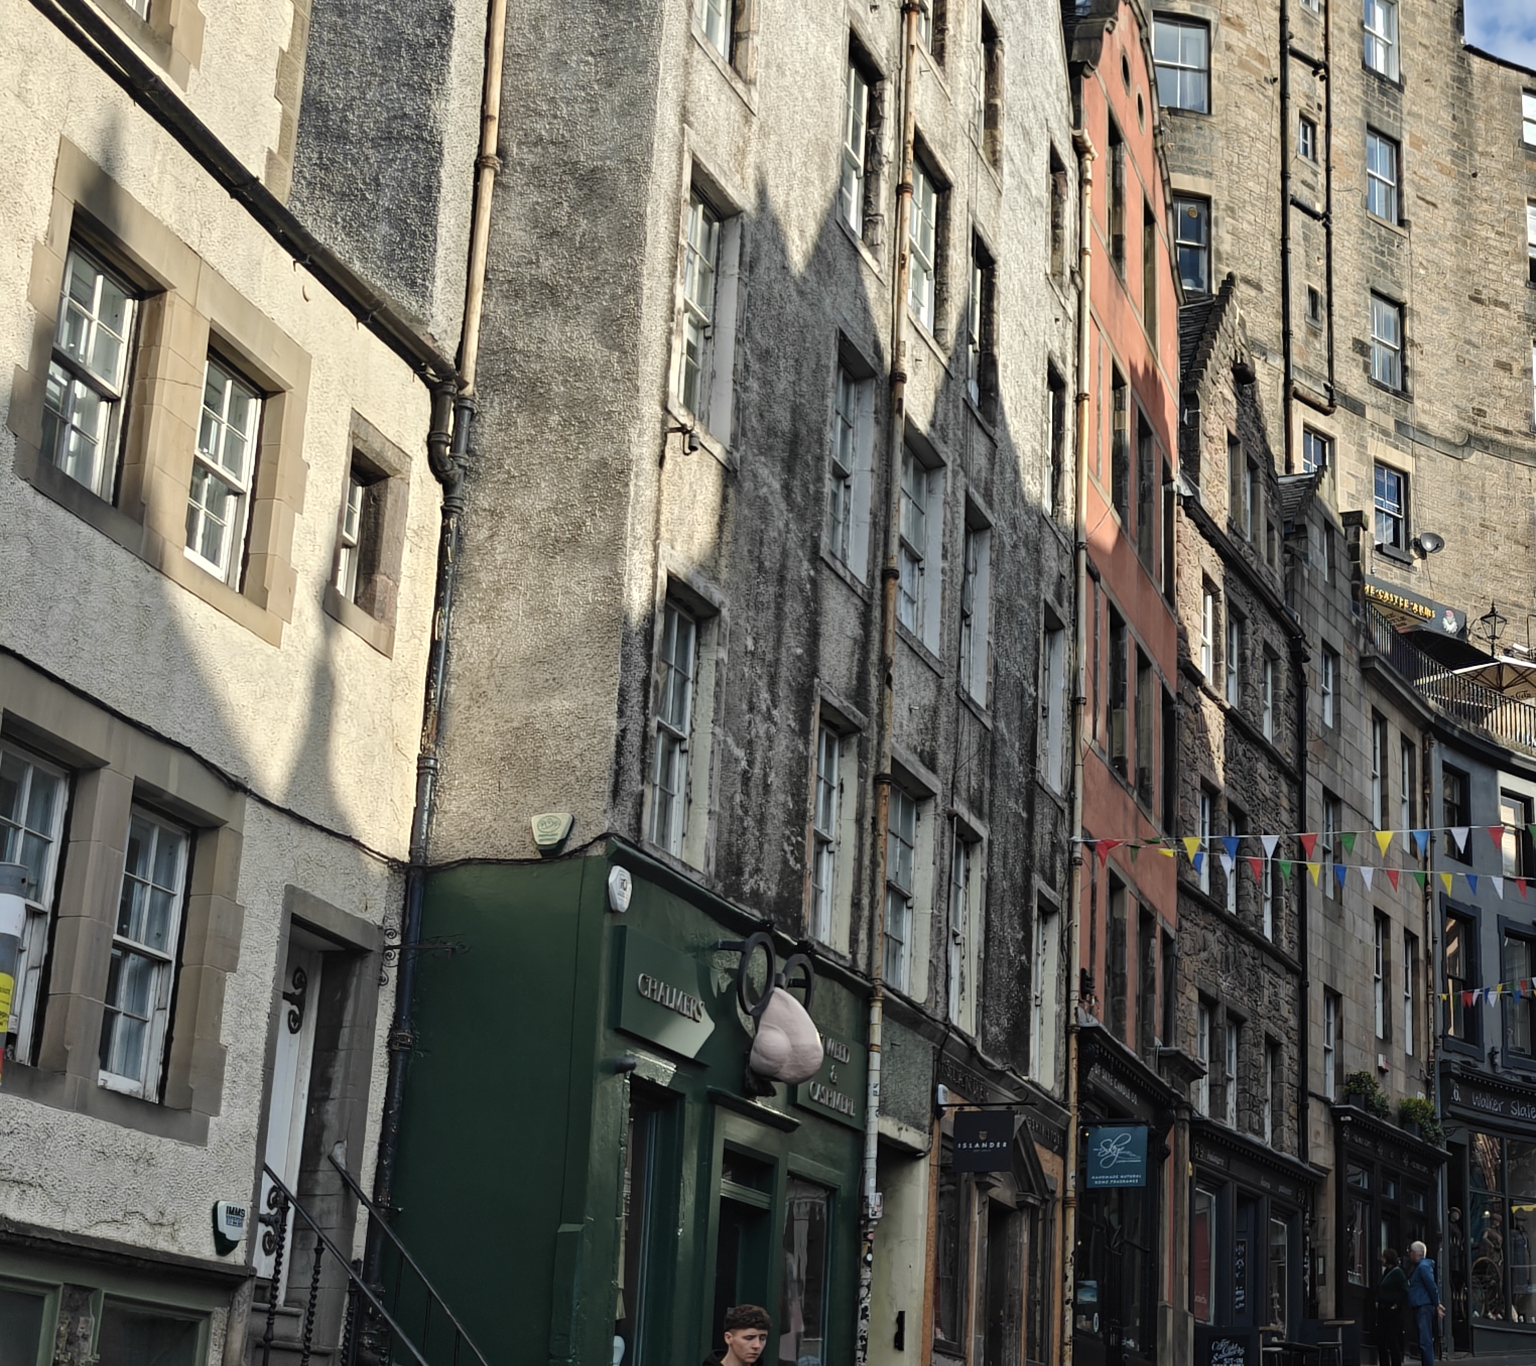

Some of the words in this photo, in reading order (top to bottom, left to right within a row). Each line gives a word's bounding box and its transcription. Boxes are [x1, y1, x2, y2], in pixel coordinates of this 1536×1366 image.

[1364, 585, 1375, 595] HE
[1376, 589, 1408, 610] CASTLE
[1412, 602, 1436, 619] ARMS
[638, 973, 706, 1023] CHALMERS
[829, 1064, 838, 1084] &
[809, 1081, 856, 1117] CASHMERE
[1471, 1091, 1505, 1113] Walker
[957, 1141, 1007, 1149] ISLANDER
[1097, 1132, 1131, 1169] Skye
